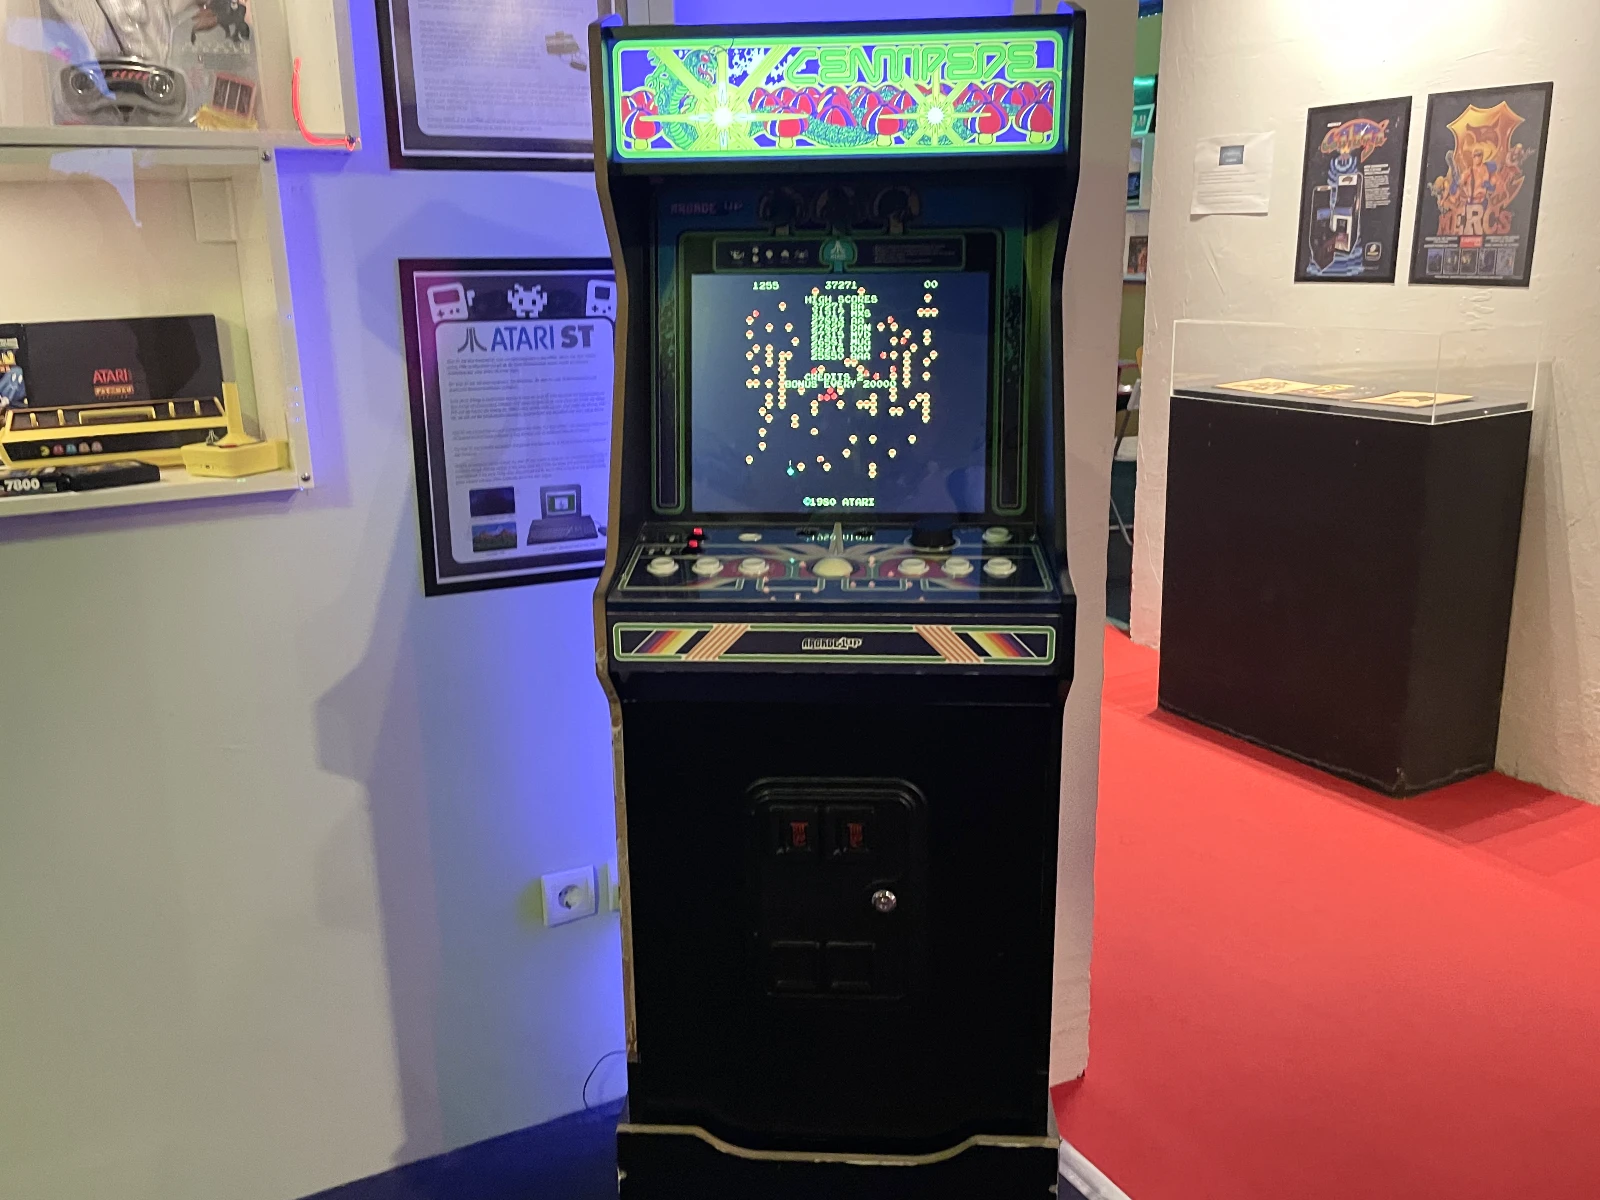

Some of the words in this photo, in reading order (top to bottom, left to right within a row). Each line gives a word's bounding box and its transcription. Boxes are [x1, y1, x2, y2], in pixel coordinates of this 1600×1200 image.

[786, 43, 1036, 85] CENTIPEDE
[1437, 203, 1513, 236] MERCS
[753, 281, 780, 290] 1255
[824, 280, 858, 290] 37271
[923, 279, 939, 289] 00
[804, 295, 832, 304] HIGH
[838, 295, 878, 304] SCORES
[850, 324, 872, 332] DAN
[490, 325, 555, 352] ATARI
[560, 324, 595, 348] ST
[850, 352, 872, 361] AAA
[93, 368, 129, 384] ATARI
[803, 372, 851, 381] CREDITS
[856, 372, 864, 382] 2
[784, 380, 818, 389] BONUS
[823, 380, 857, 389] EVERY
[862, 380, 898, 389] 20000
[4, 477, 41, 492] 7800
[841, 497, 875, 507] ATARI
